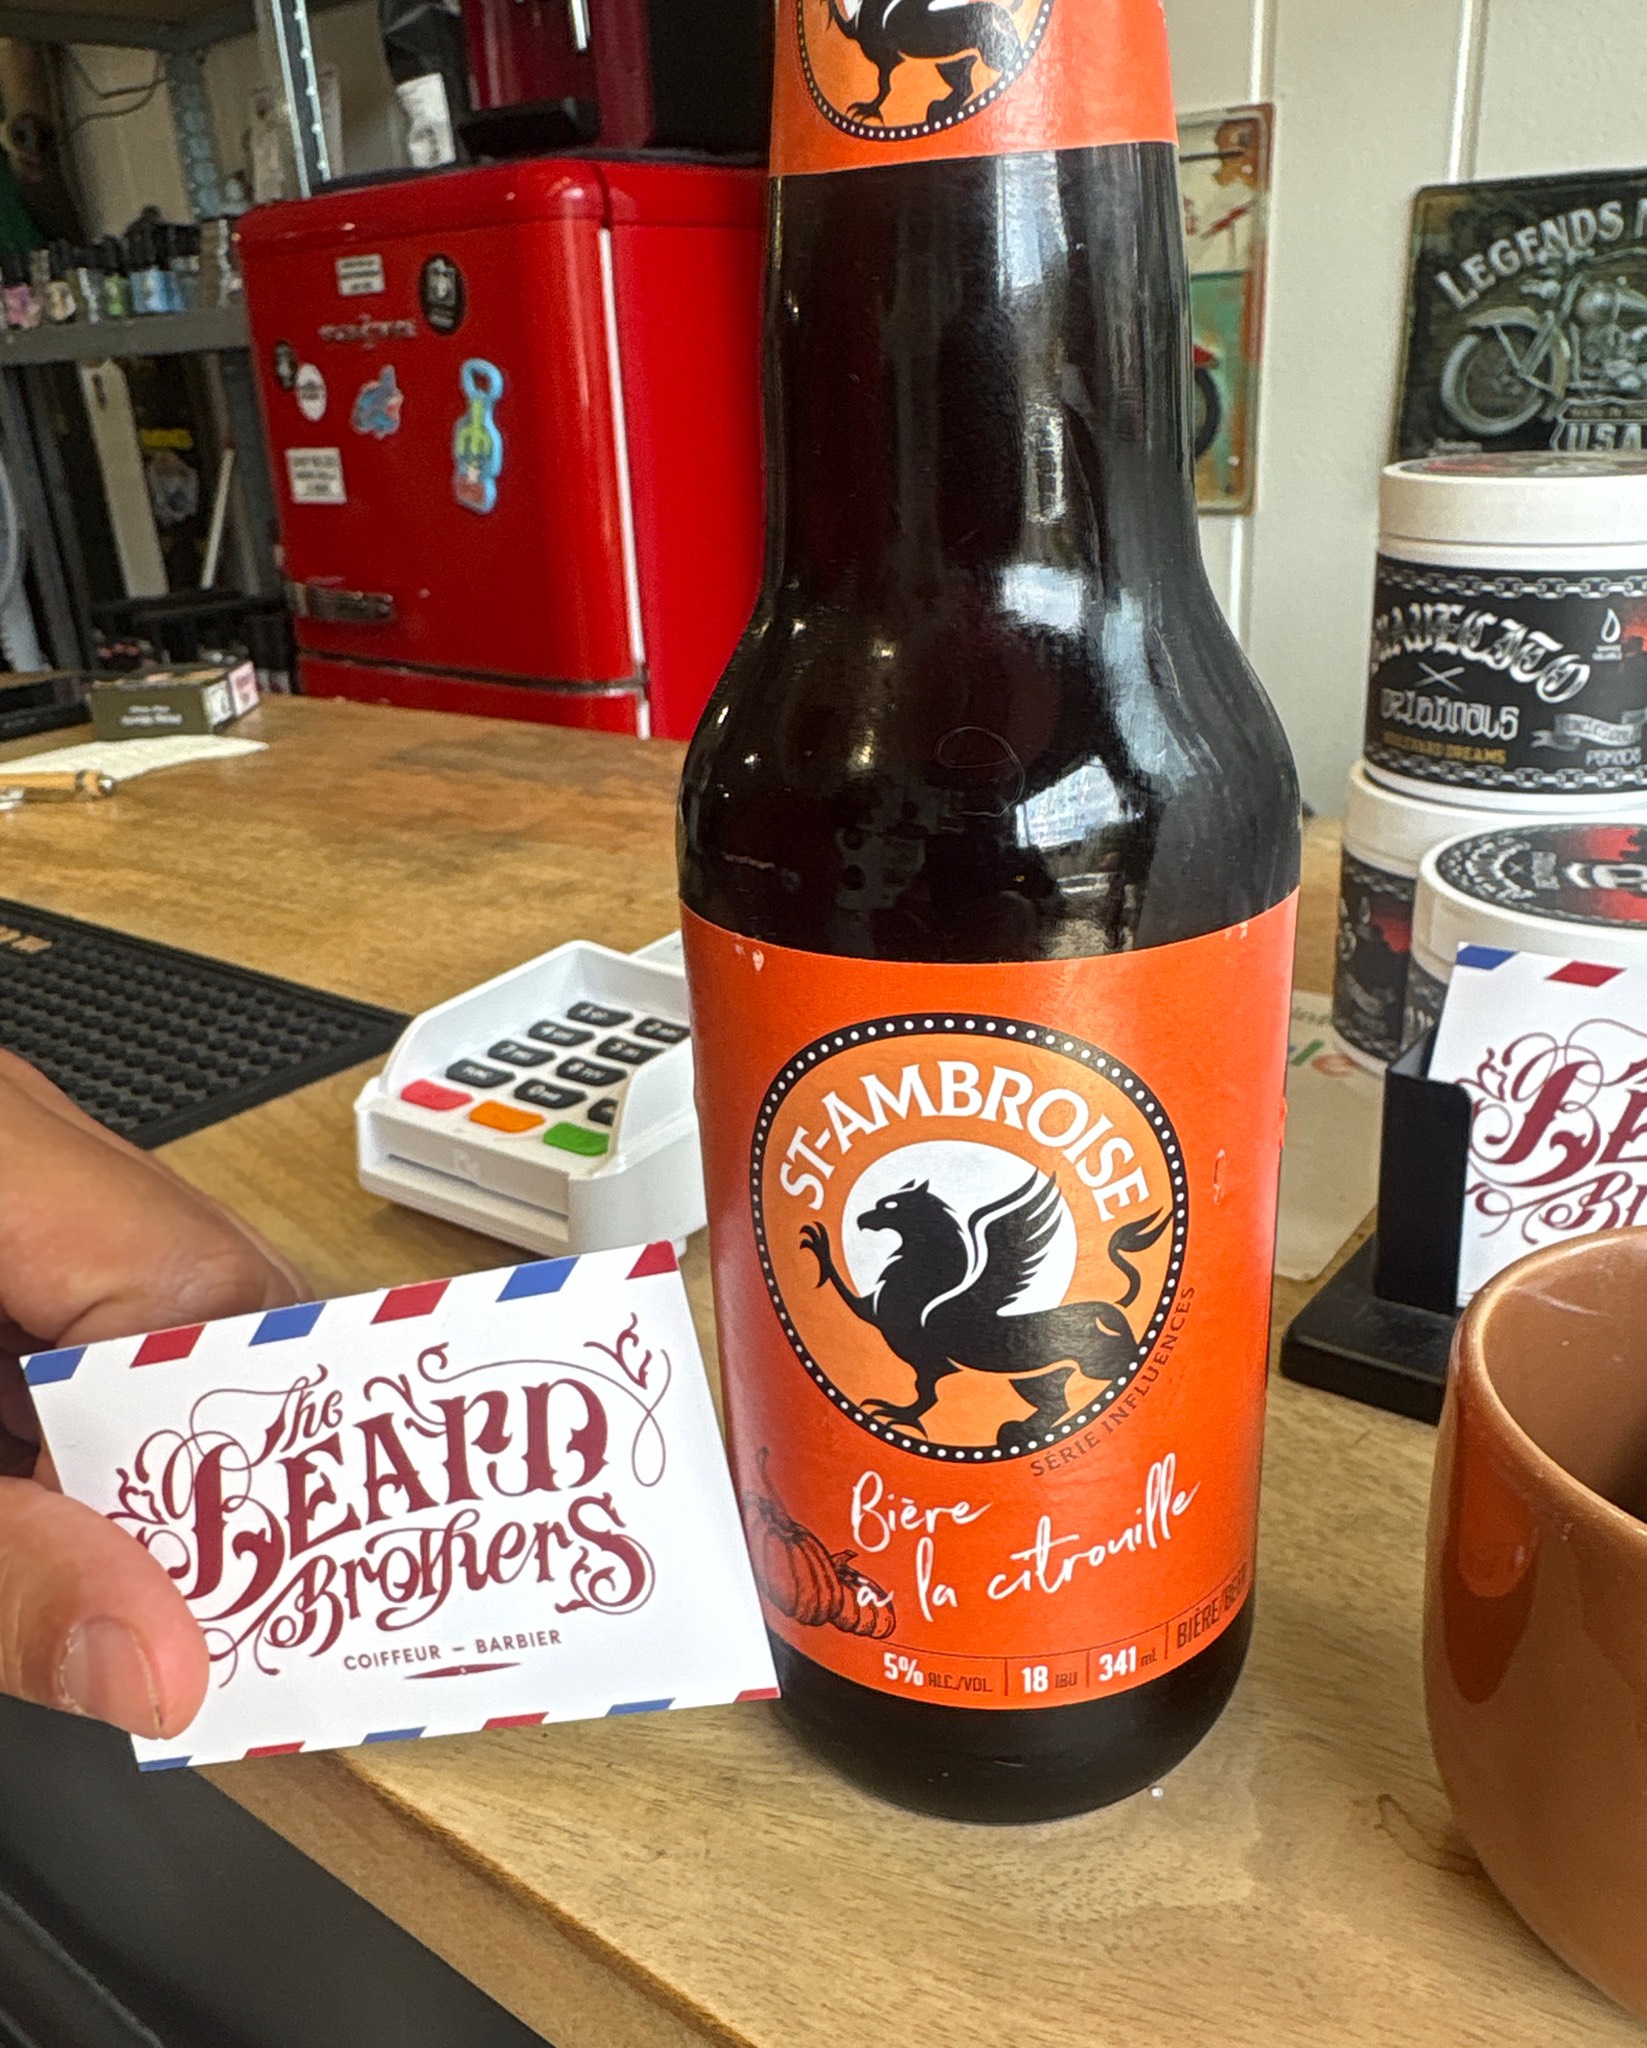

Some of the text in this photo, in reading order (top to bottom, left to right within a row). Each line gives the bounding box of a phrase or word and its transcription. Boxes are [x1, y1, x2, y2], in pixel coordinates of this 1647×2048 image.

[1435, 200, 1625, 309] LEGENDS
[779, 1061, 1150, 1222] ST-AMBROISE
[252, 1363, 344, 1467] The
[1029, 1286, 1196, 1477] SÉRIE INFLUENCES
[851, 1470, 994, 1553] Bière
[856, 1452, 1202, 1622] à la citrouille
[343, 1644, 441, 1671] COIFFEUR
[475, 1629, 562, 1654] BARBIER
[883, 1652, 925, 1687] 5%
[1021, 1665, 1049, 1694] 18
[1099, 1645, 1138, 1682] 341
